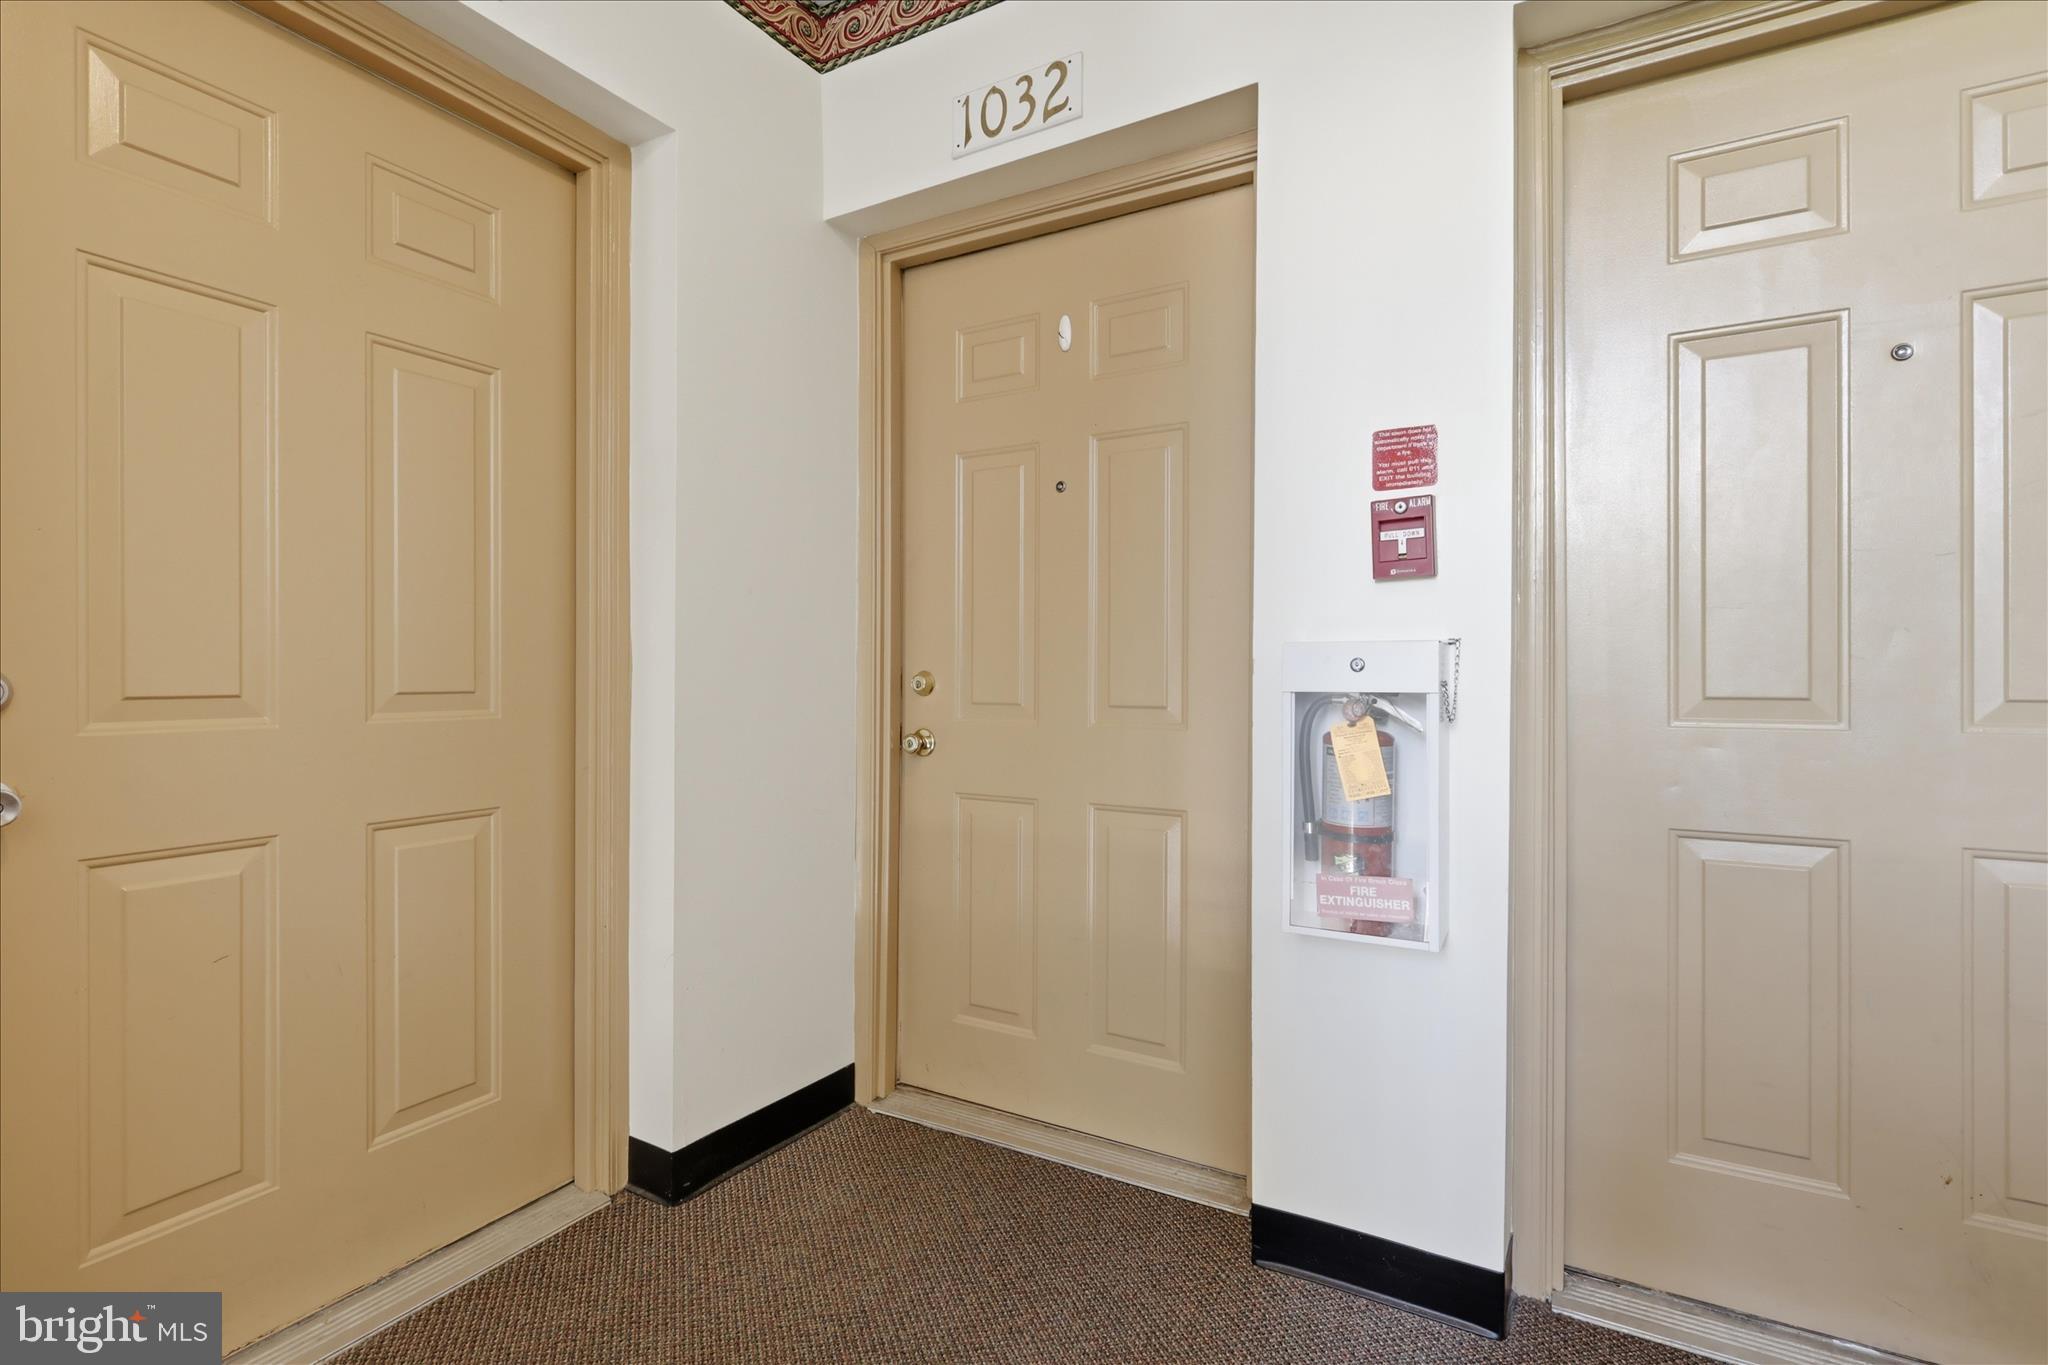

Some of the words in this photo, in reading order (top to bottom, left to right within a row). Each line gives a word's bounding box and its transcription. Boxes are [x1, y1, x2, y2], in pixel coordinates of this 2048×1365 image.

[962, 60, 1070, 149] 1032
[1375, 501, 1389, 512] FIRE
[1409, 496, 1432, 508] ALARM
[1402, 530, 1420, 538] DOWN
[1350, 886, 1377, 897] FIRE
[1319, 895, 1410, 911] EXTINGUISHER
